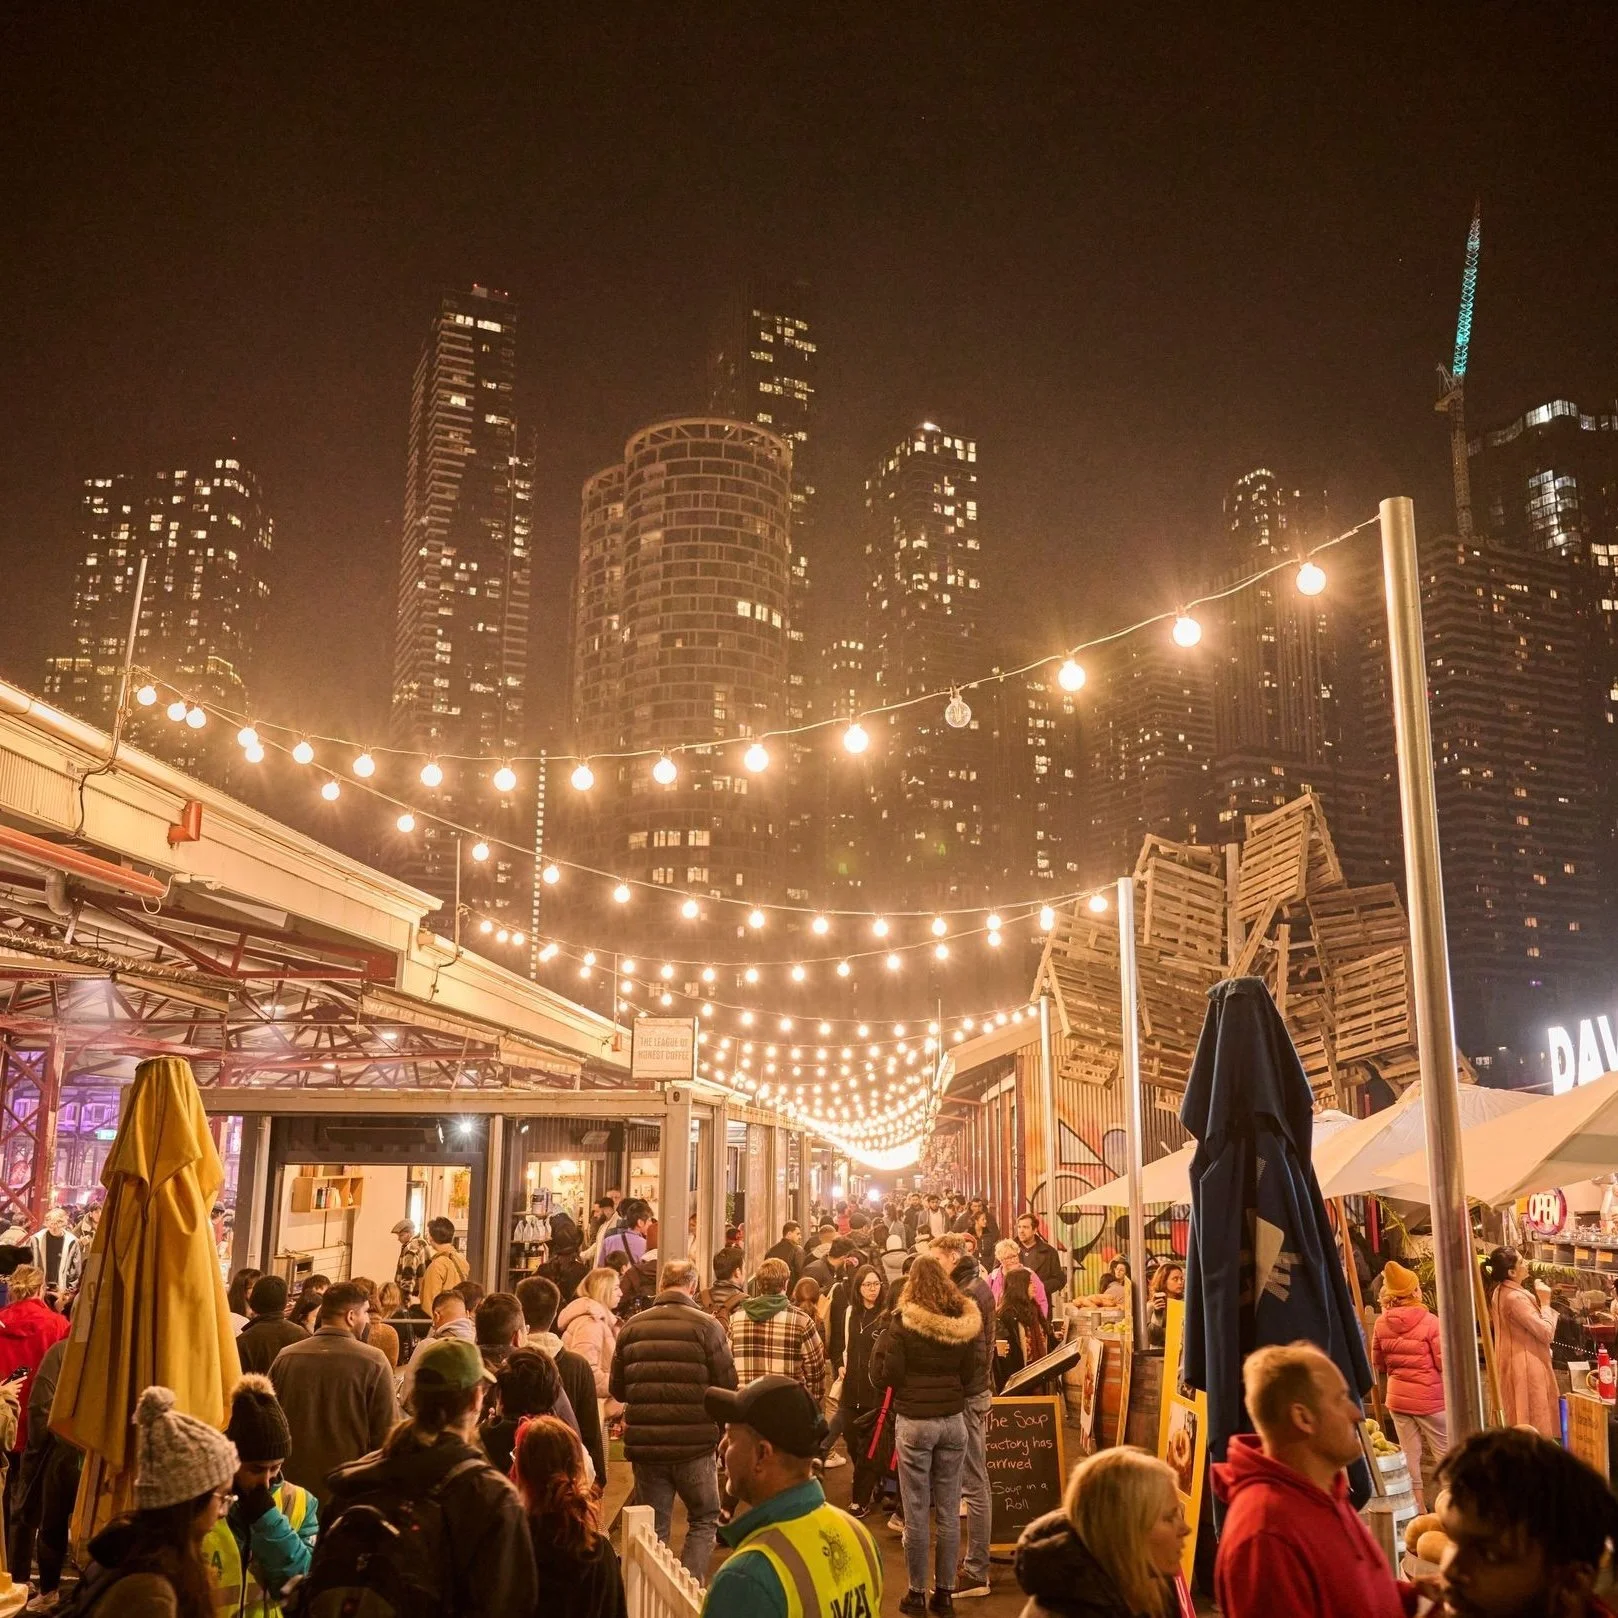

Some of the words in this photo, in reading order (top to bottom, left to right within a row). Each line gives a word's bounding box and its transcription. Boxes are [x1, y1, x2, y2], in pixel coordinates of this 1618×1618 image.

[640, 1037, 652, 1047] THE
[654, 1037, 678, 1047] LEAGUE
[680, 1038, 689, 1047] OF
[638, 1050, 664, 1060] HONEST
[665, 1050, 689, 1060] COFFEE
[1529, 1193, 1560, 1228] OPEN
[1013, 1410, 1049, 1429] Soup
[1032, 1436, 1053, 1449] has
[986, 1459, 1032, 1470] arrived
[991, 1481, 1021, 1494] Soup
[1005, 1498, 1029, 1511] Roll
